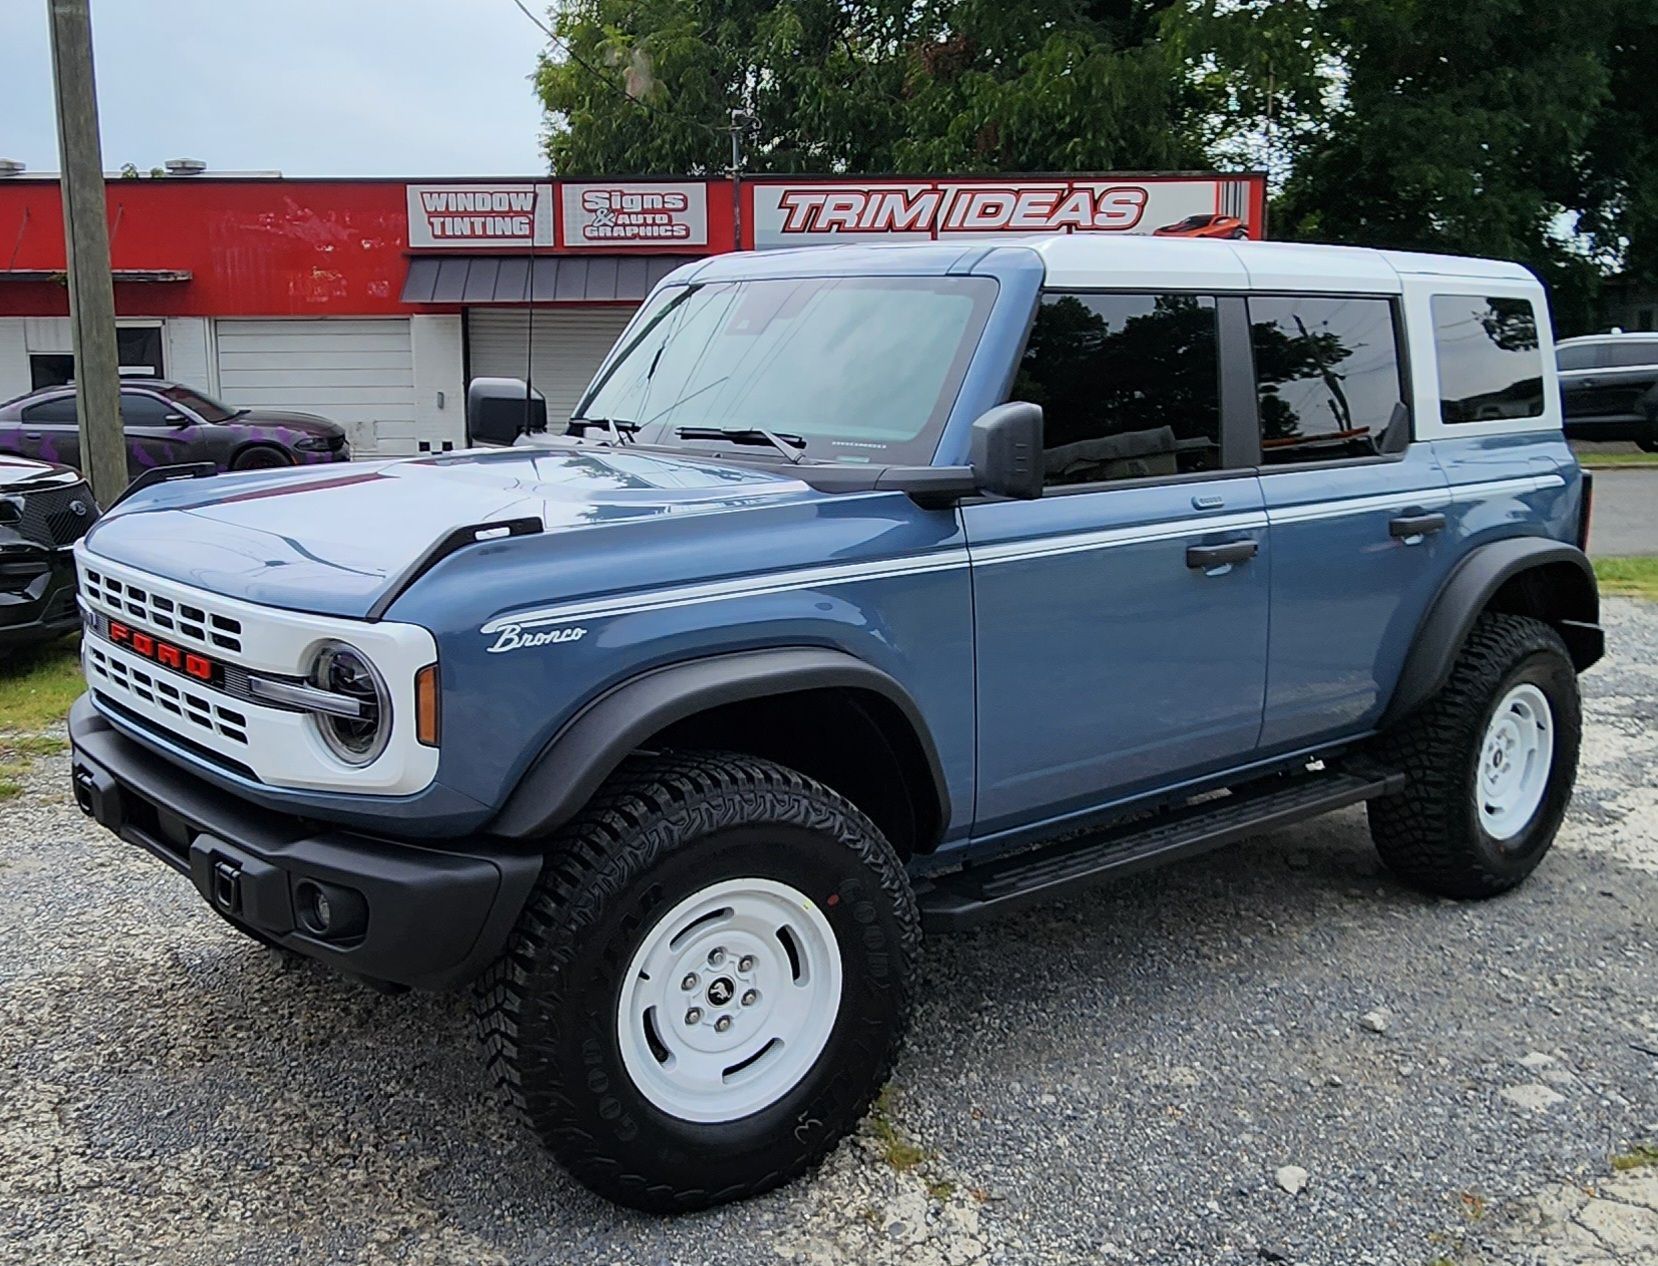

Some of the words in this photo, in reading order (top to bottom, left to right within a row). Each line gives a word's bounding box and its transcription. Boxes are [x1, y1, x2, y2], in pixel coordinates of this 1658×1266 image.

[420, 191, 536, 212] WINDOW
[583, 191, 686, 212] Signs
[781, 190, 942, 231] TRIM
[944, 188, 1146, 230] IDEAS
[428, 216, 531, 237] TINTING
[593, 208, 616, 227] &
[617, 213, 669, 225] AUTO
[584, 225, 687, 238] GRAPHICS
[487, 623, 588, 652] Bronco
[111, 622, 211, 679] FORD
